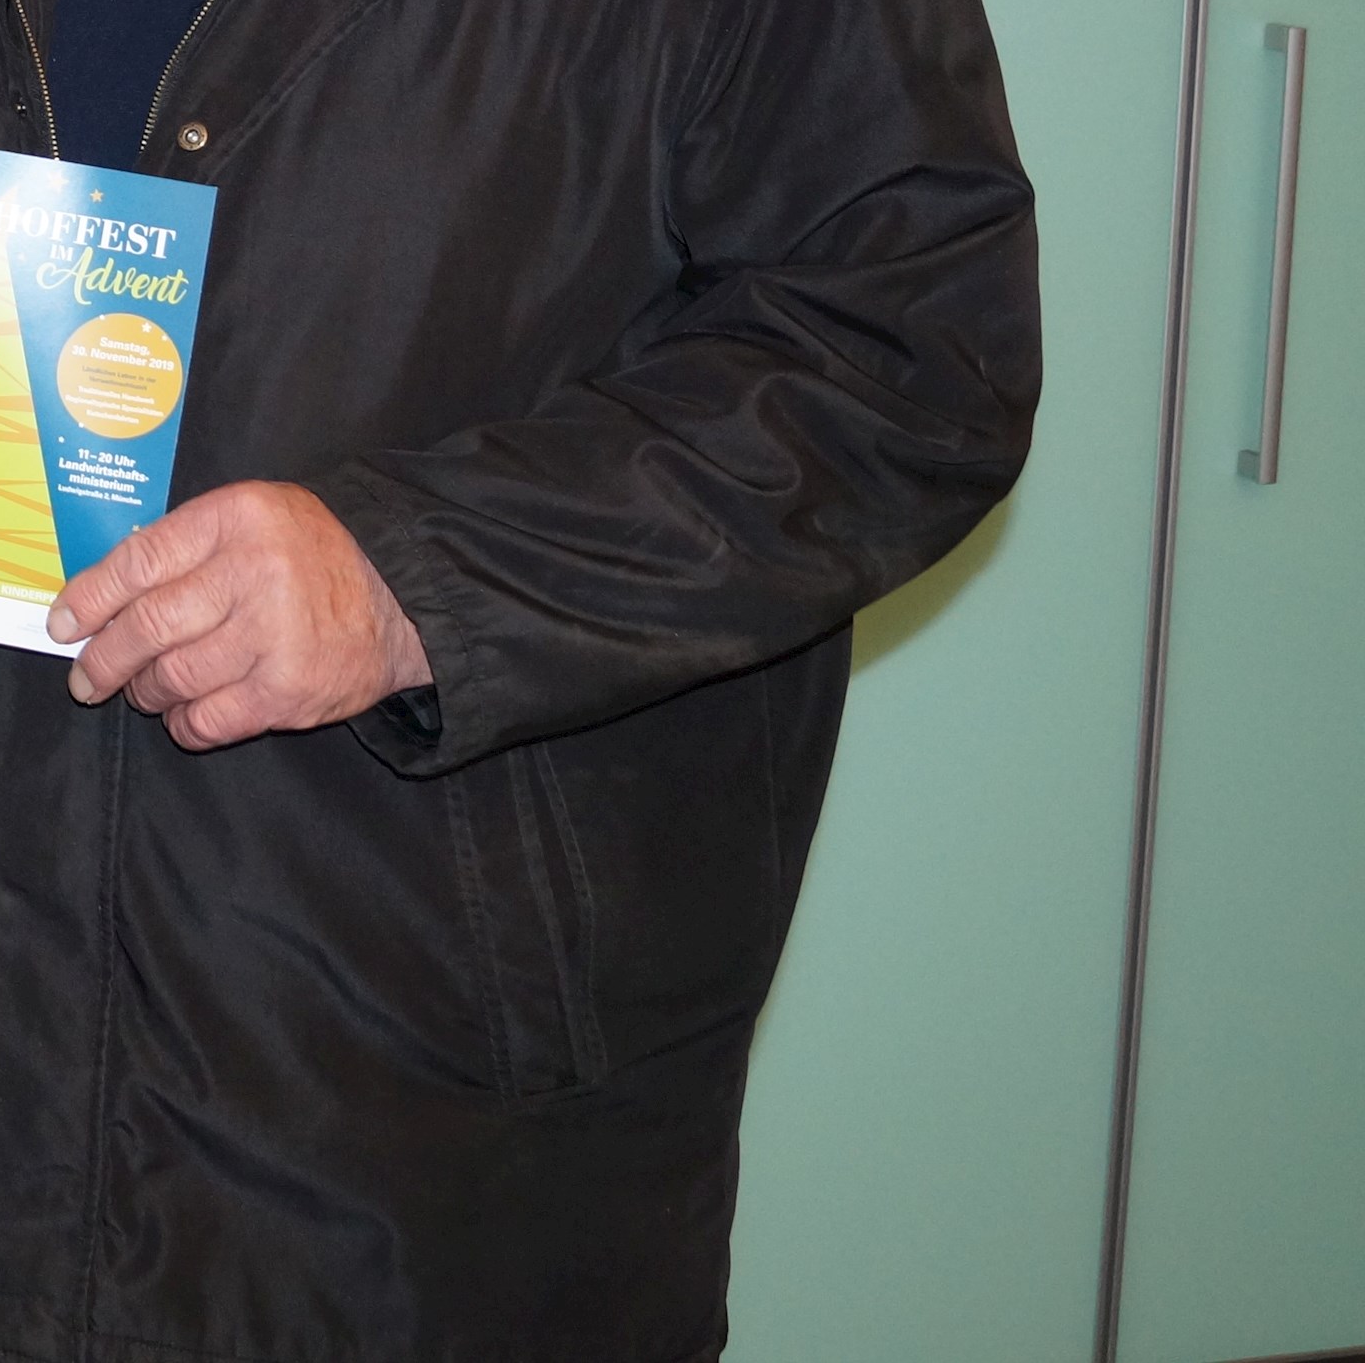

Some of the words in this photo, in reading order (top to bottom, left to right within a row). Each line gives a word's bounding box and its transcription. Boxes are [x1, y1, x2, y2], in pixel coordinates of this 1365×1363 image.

[50, 244, 74, 262] IM
[36, 246, 189, 305] Advent
[100, 336, 150, 356] Samstag,
[71, 344, 88, 358] 30.
[90, 347, 147, 367] November
[148, 358, 175, 371] 2019
[58, 457, 149, 483] Landwirtschafts-
[114, 454, 136, 468] Uhr
[69, 474, 135, 493] ministerium
